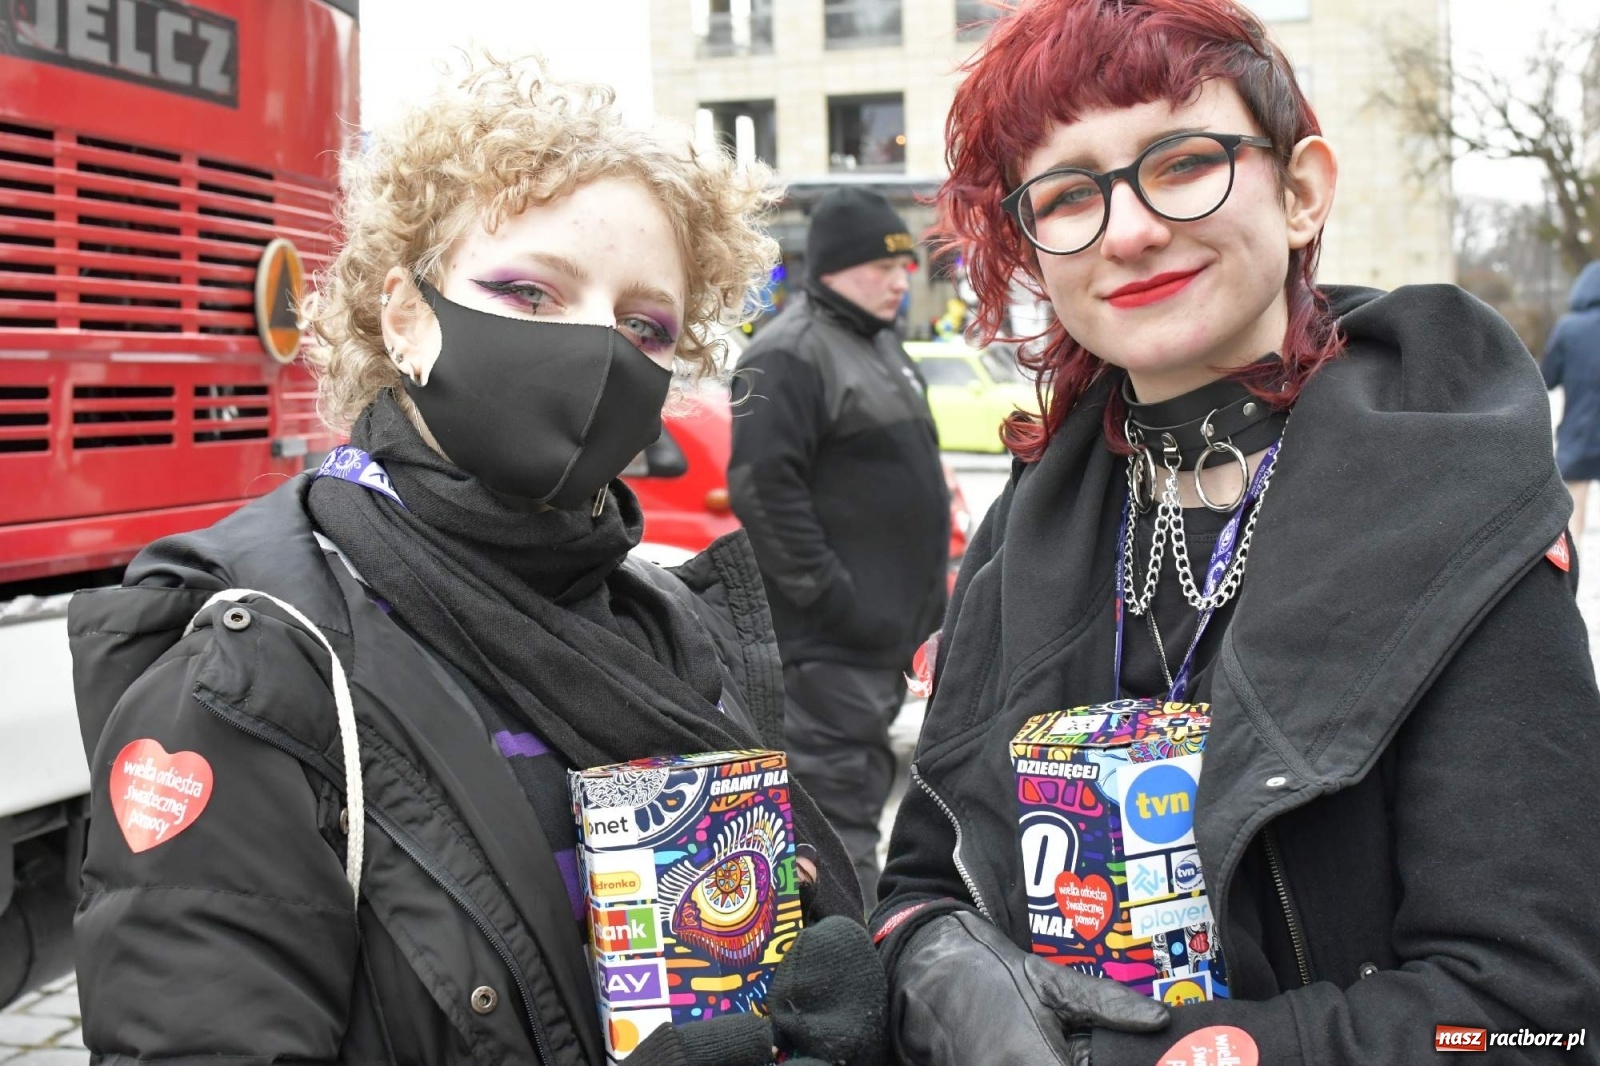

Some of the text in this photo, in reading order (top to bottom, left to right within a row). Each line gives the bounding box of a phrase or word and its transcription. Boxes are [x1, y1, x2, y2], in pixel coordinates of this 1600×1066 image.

[17, 0, 232, 95] JELCZ
[710, 769, 788, 796] GRAMY DLA
[1017, 759, 1098, 779] DZIECIĘCEJ
[1136, 791, 1190, 819] tvn
[127, 808, 170, 841] pomocy
[1074, 914, 1099, 931] pomocy
[1141, 903, 1208, 934] player
